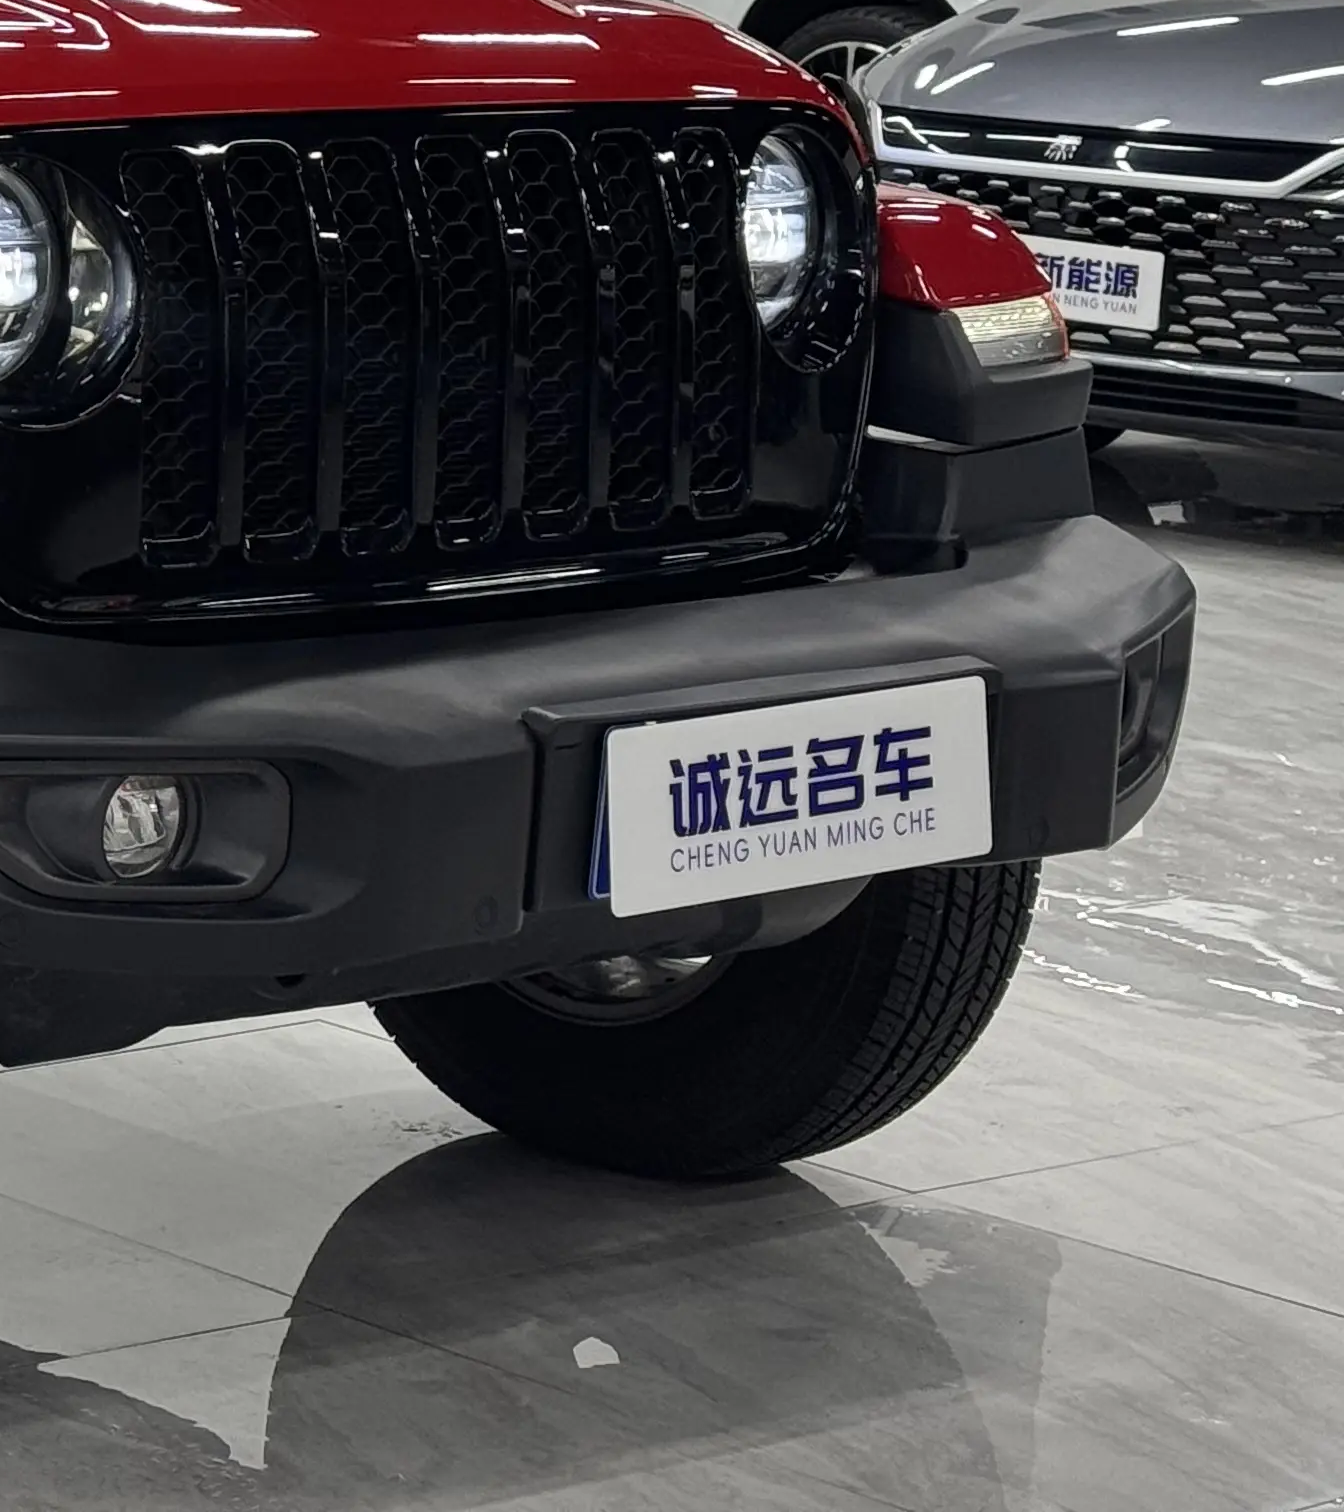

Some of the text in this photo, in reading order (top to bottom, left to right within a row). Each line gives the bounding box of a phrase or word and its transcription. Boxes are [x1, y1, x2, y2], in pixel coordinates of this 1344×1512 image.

[1064, 295, 1099, 309] NENG
[1102, 300, 1138, 315] YUAN
[669, 726, 933, 837] 诚远名车
[670, 807, 937, 873] CHENG YUAN MING CHE
